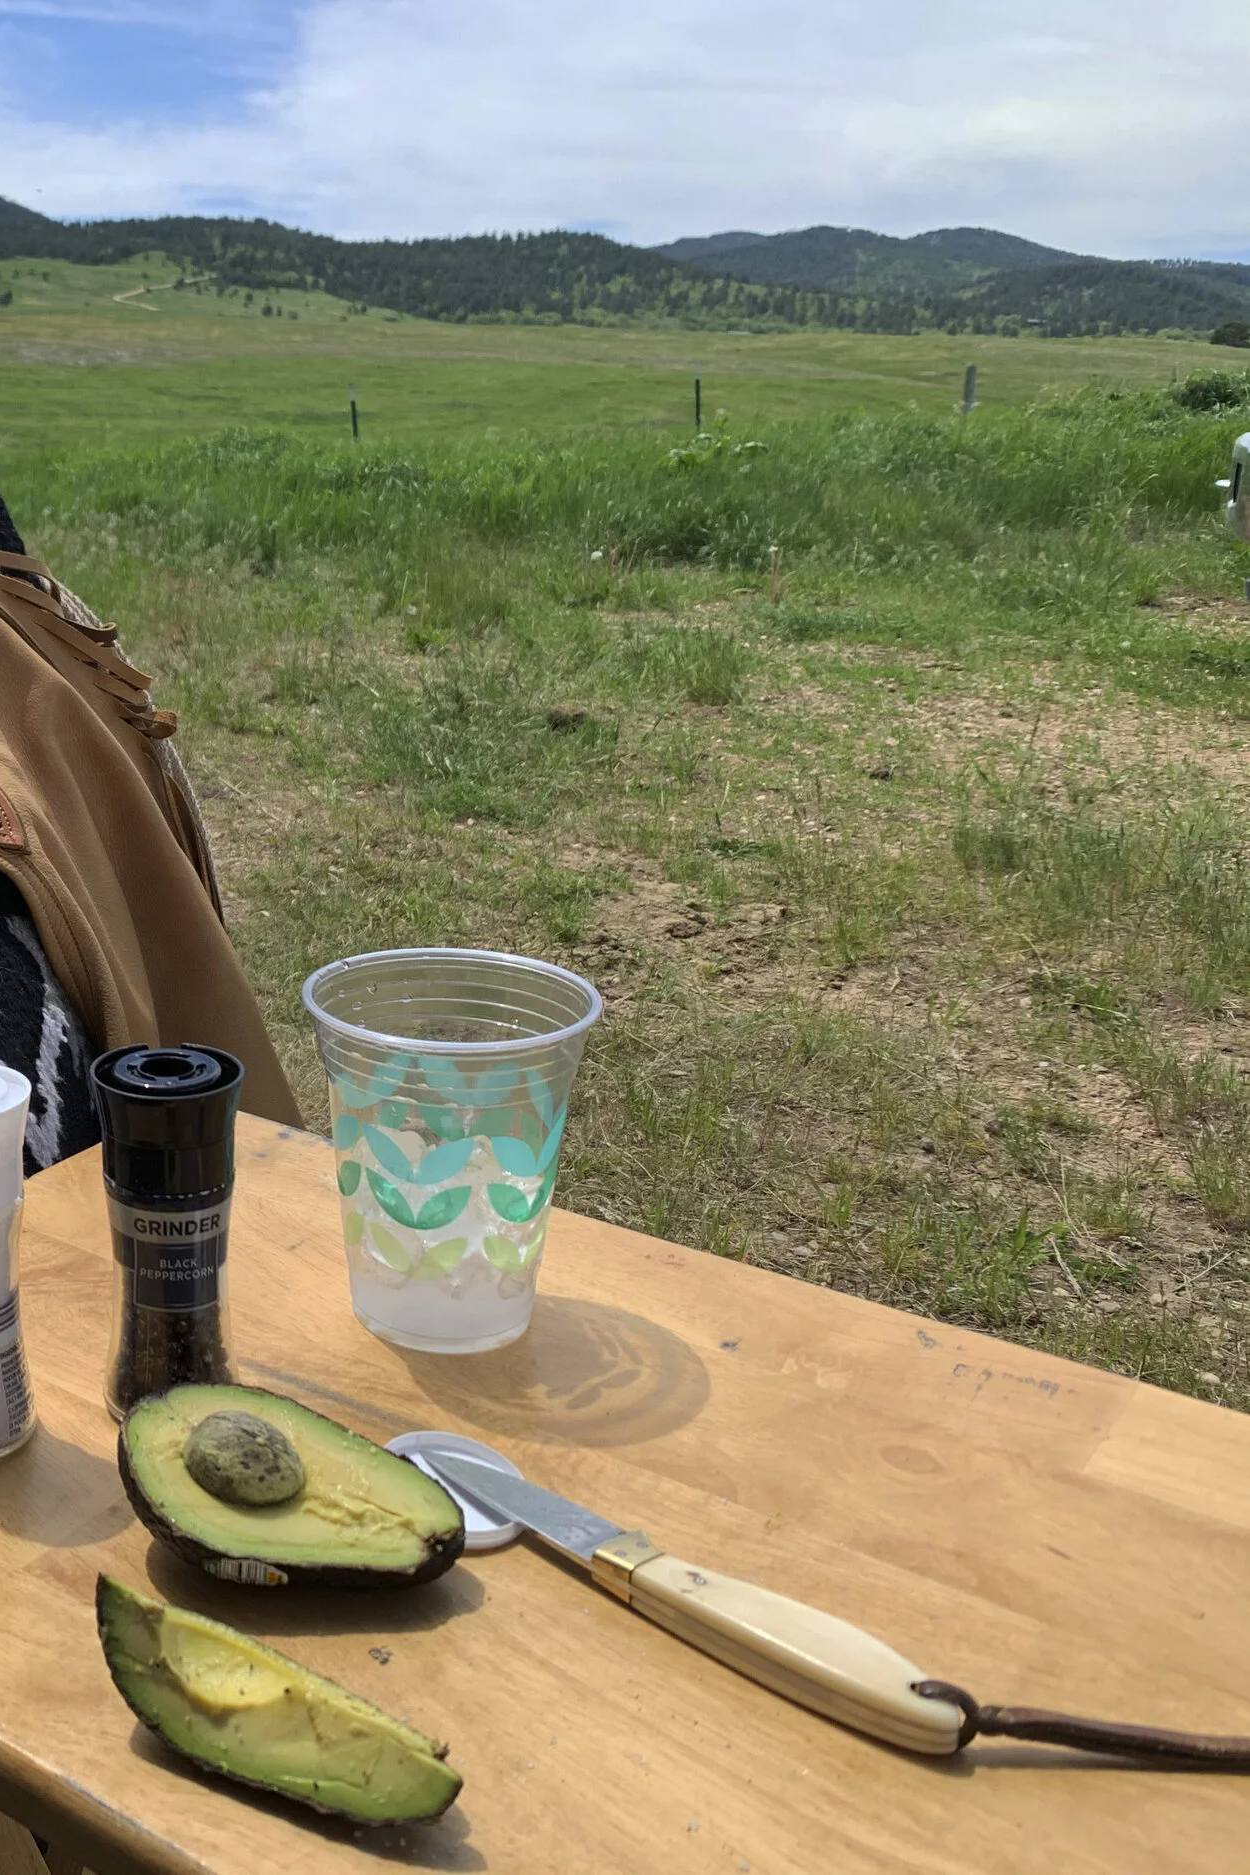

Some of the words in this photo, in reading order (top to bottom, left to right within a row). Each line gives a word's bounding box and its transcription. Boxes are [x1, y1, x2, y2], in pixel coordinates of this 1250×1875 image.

[133, 1214, 220, 1236] GRINDER
[160, 1258, 198, 1269] BLACK
[140, 1266, 214, 1281] PEPPERCORN
